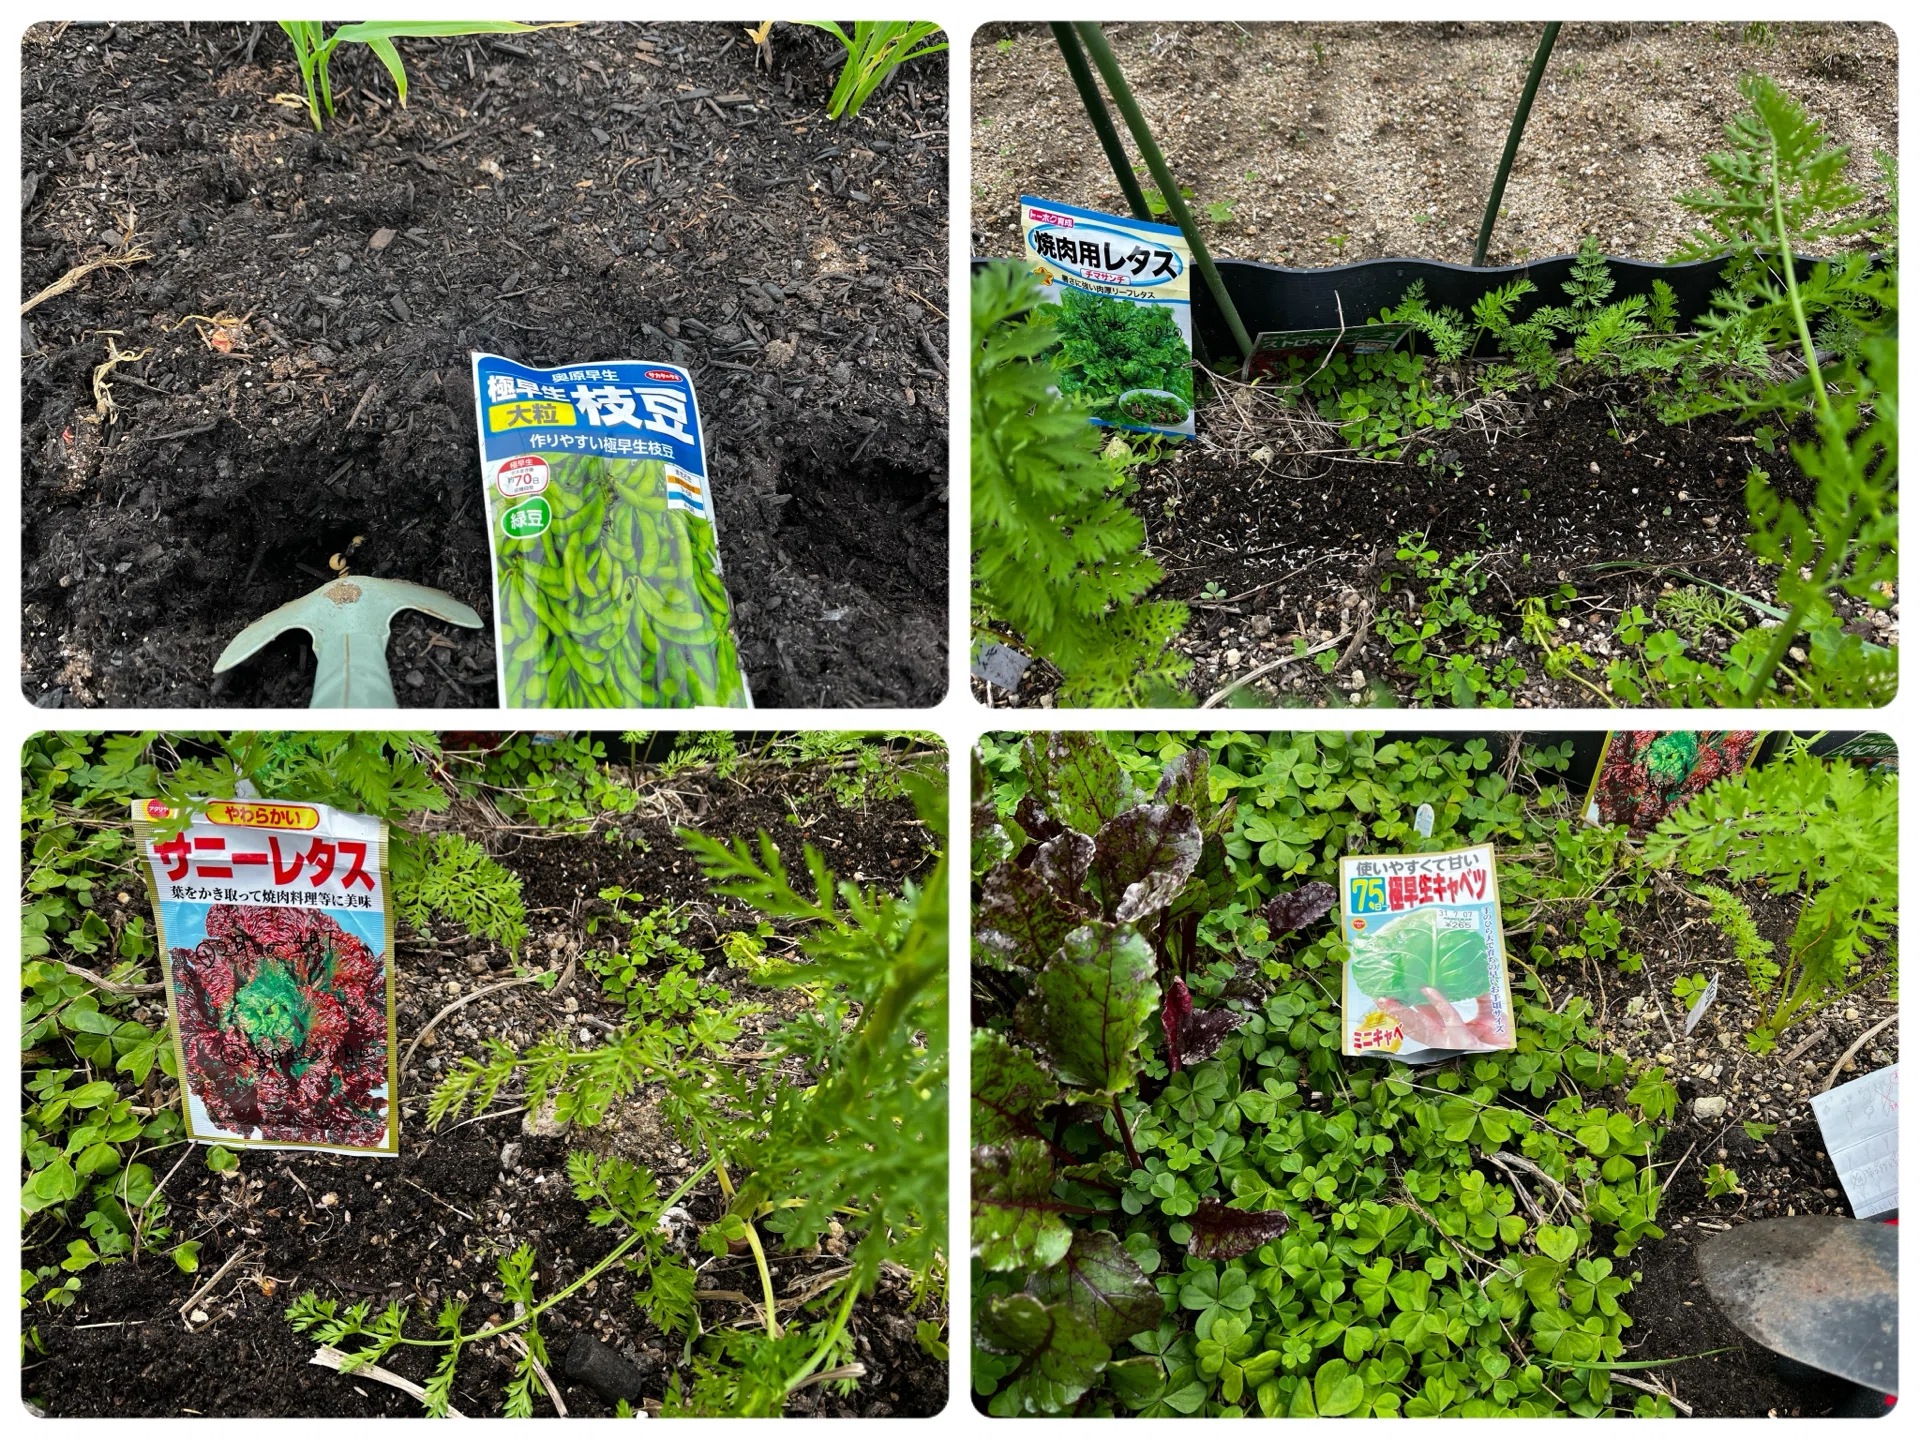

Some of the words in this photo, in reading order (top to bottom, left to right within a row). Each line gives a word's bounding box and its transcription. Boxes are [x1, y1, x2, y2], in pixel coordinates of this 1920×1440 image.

[1035, 229, 1178, 280] 焼肉用レタス
[1061, 274, 1156, 299] 暑さに強い肉厚リーフレタス
[1085, 270, 1125, 284] チマサンチ
[552, 369, 620, 383] 奥原早生
[487, 375, 568, 402] 極早生
[507, 404, 559, 427] 大粒
[571, 384, 695, 445] 枝豆
[530, 433, 675, 459] 作りやすい極早生枝豆
[511, 509, 544, 529] 緑豆
[225, 805, 301, 825] やわらかい
[153, 831, 376, 892] サニーレタス
[1356, 854, 1479, 877] 使いやすくて甘い
[170, 885, 372, 909] 葉をかき取って焼肉料理等に美味
[1388, 868, 1487, 911] 極早生キャベツ
